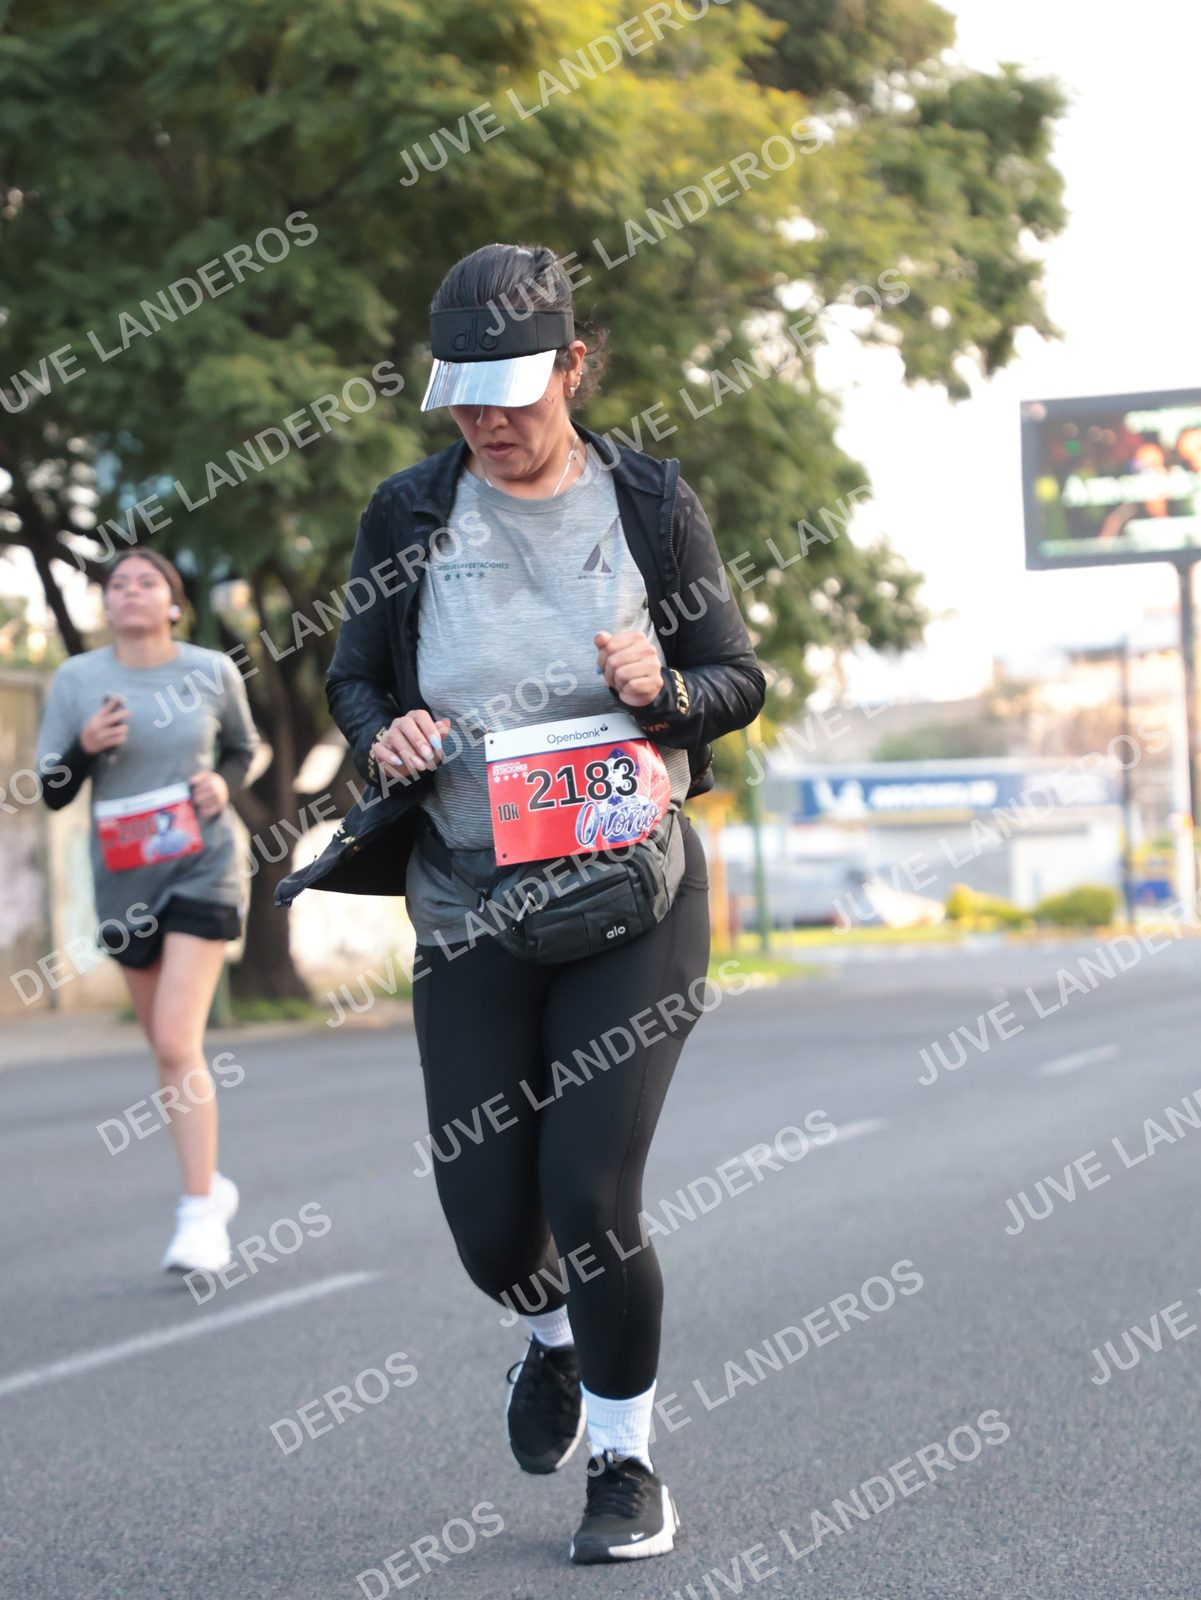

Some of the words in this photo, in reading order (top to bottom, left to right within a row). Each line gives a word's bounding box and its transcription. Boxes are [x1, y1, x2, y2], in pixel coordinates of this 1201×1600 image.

[451, 316, 498, 351] alo
[547, 728, 600, 744] Openbank
[526, 756, 638, 811] 2183
[606, 925, 626, 939] alo
